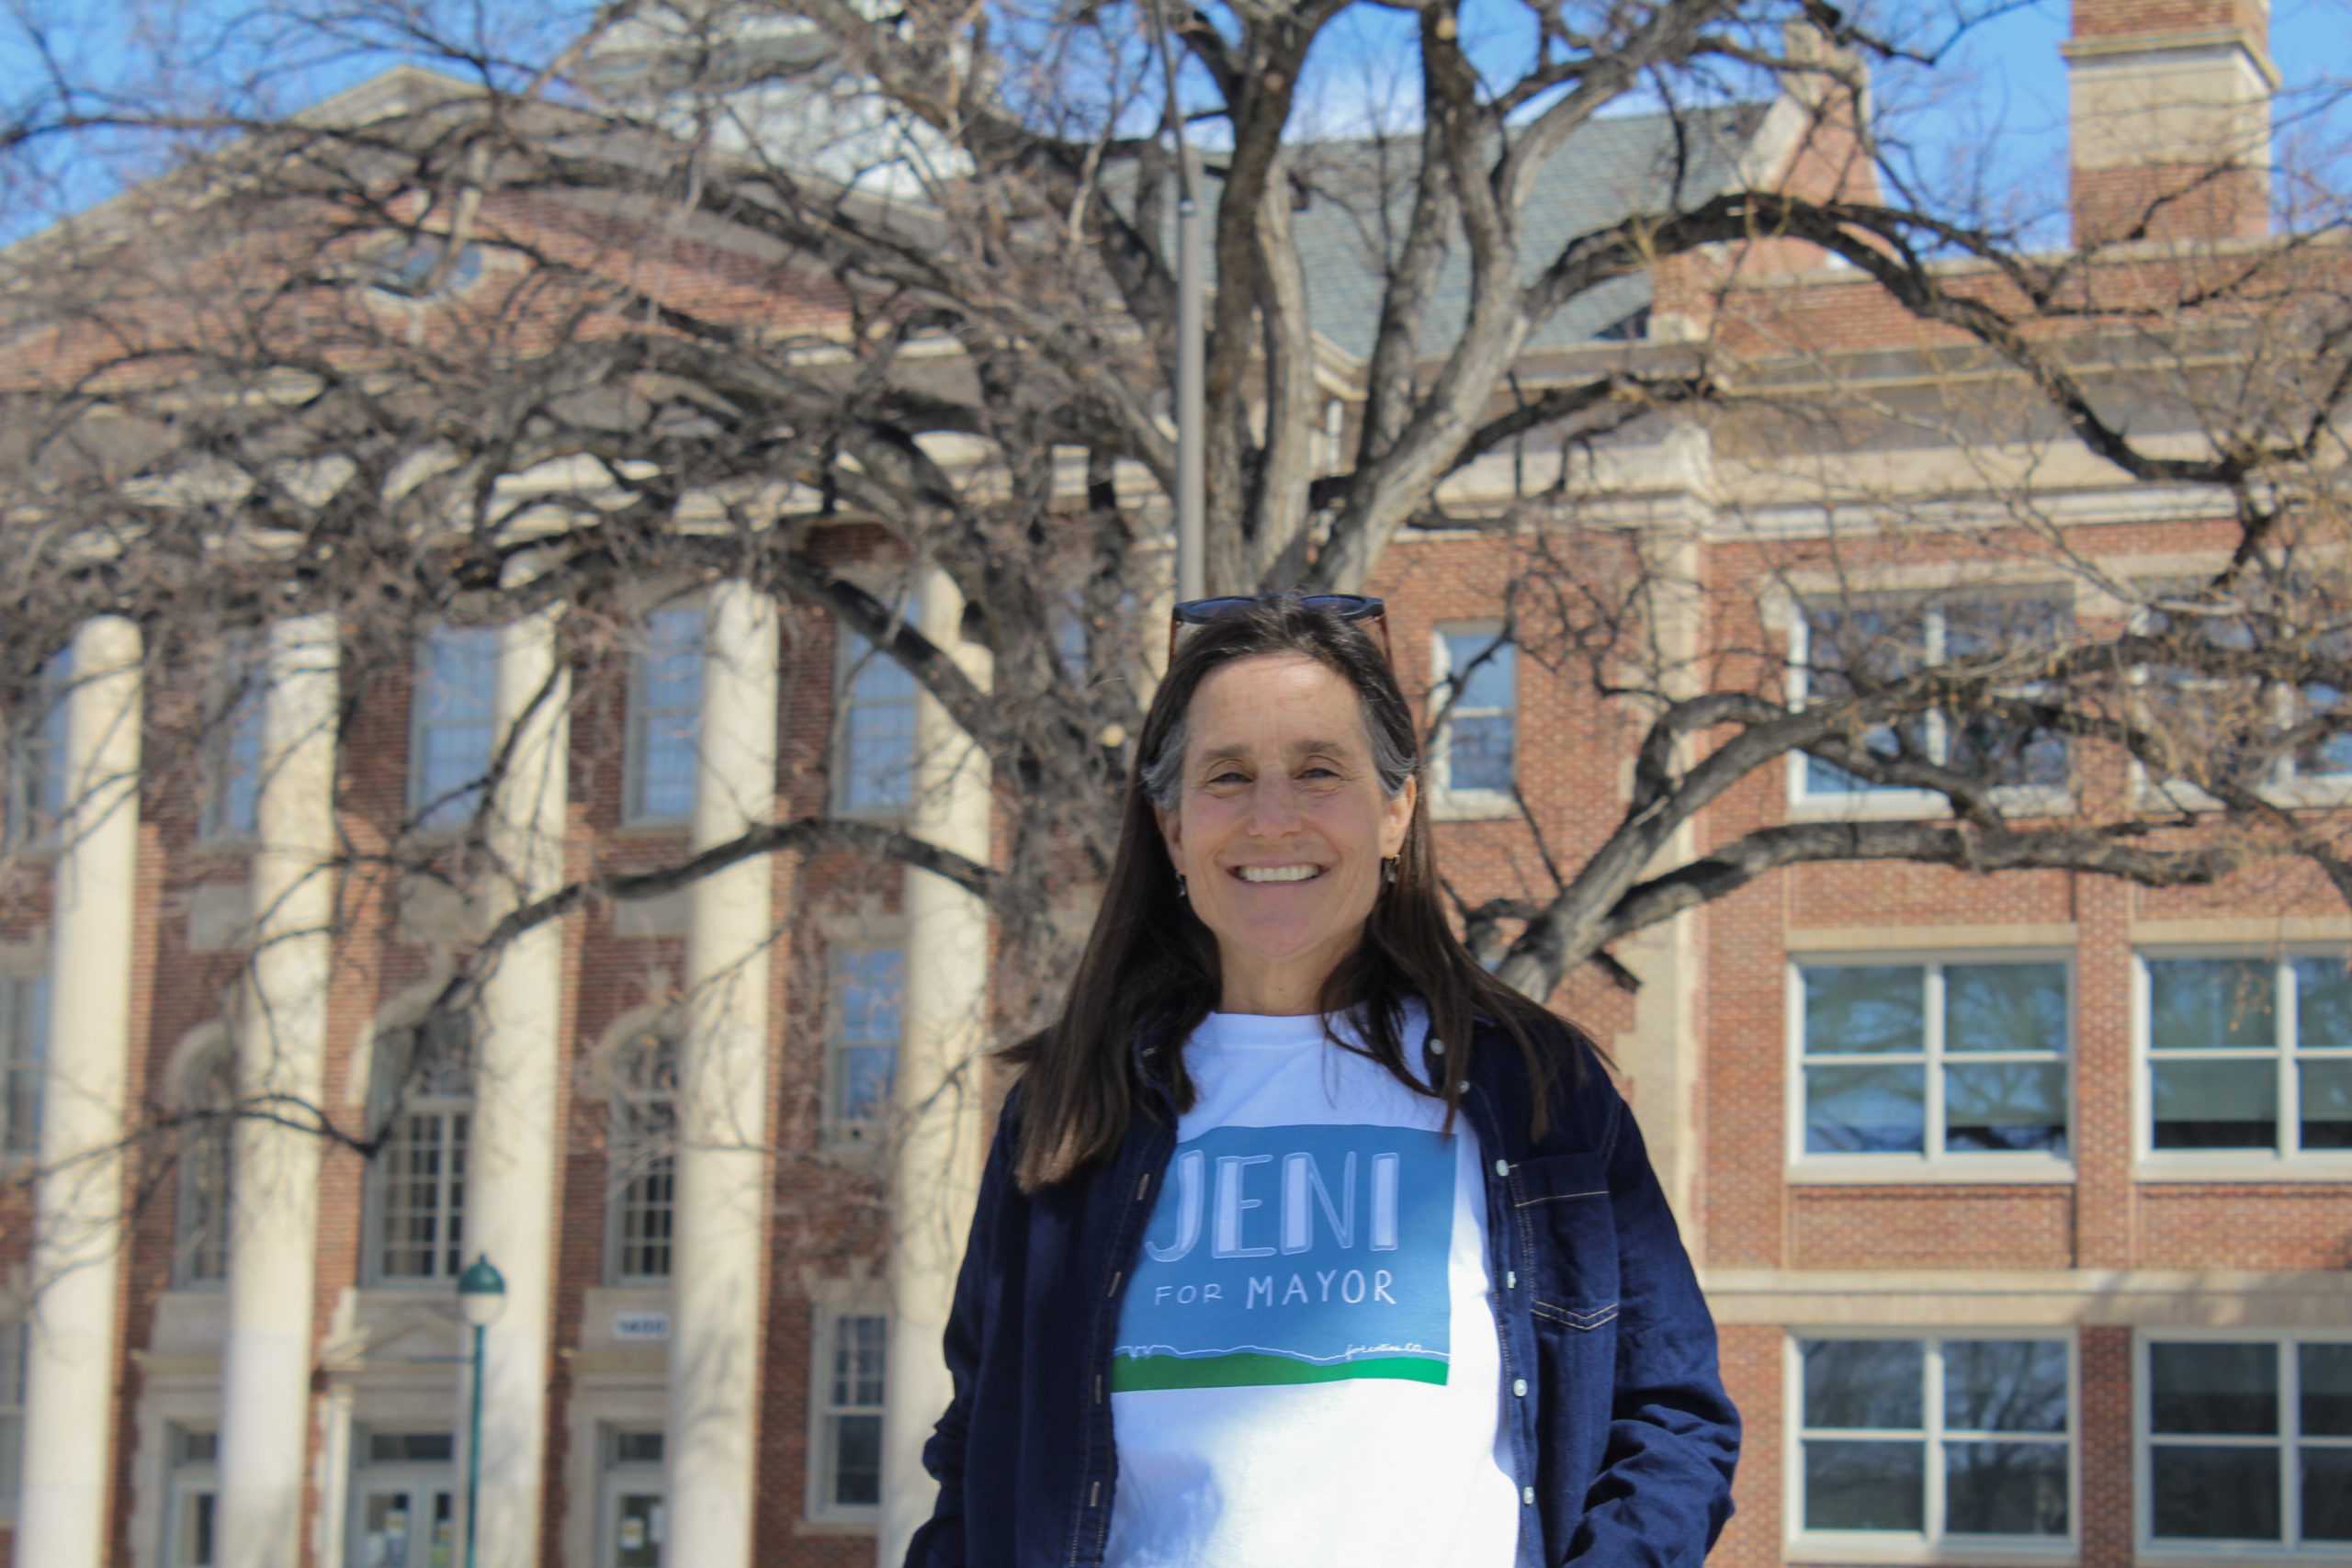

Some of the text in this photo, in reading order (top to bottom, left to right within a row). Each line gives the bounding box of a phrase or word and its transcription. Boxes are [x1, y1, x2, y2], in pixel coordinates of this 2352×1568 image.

[1145, 1149, 1400, 1262] JENI
[1154, 1269, 1397, 1309] FOR MAYOR
